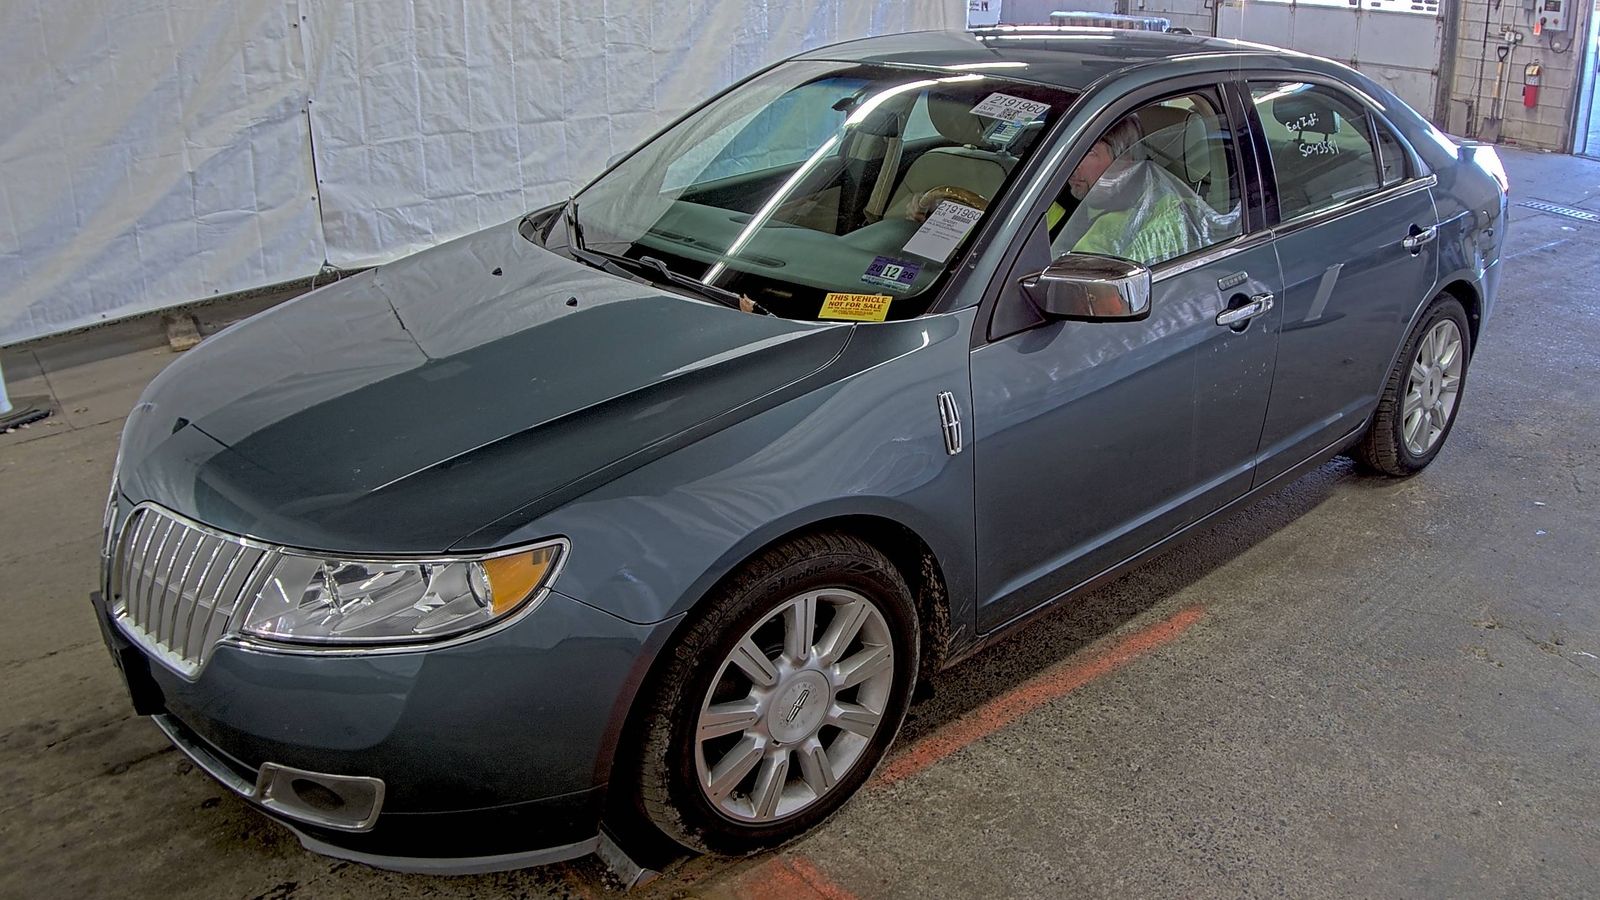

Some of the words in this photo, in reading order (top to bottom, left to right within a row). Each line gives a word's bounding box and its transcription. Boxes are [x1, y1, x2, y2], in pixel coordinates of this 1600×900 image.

[990, 95, 1045, 114] 2191960
[938, 202, 981, 221] 2191960
[882, 266, 900, 278] 12
[851, 295, 888, 304] VEHICLE
